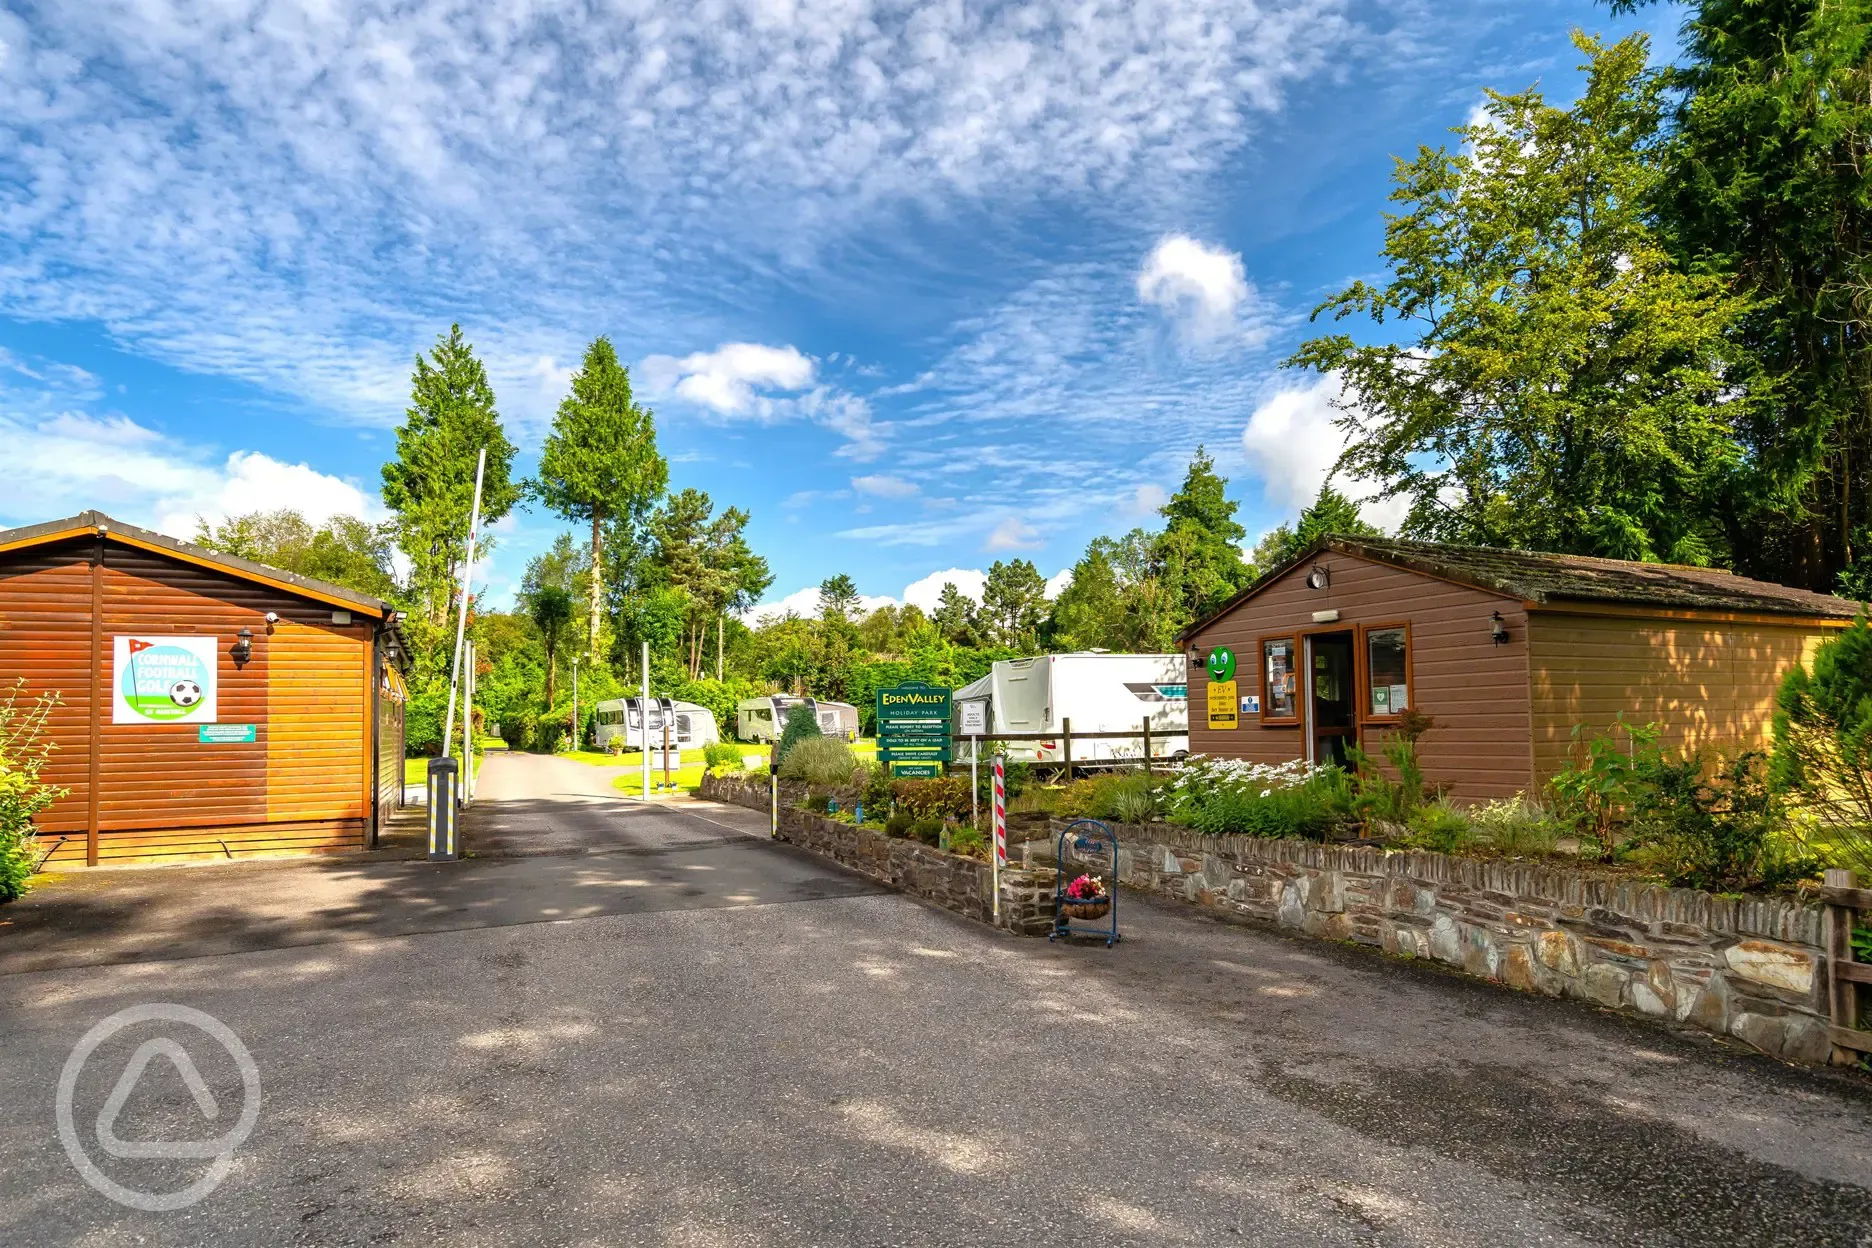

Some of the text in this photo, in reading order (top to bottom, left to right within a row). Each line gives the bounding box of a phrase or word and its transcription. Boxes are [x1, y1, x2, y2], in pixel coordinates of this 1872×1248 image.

[138, 654, 199, 666] CORNWALL
[138, 667, 198, 678] FOOTBALL
[138, 680, 172, 692] GOLF
